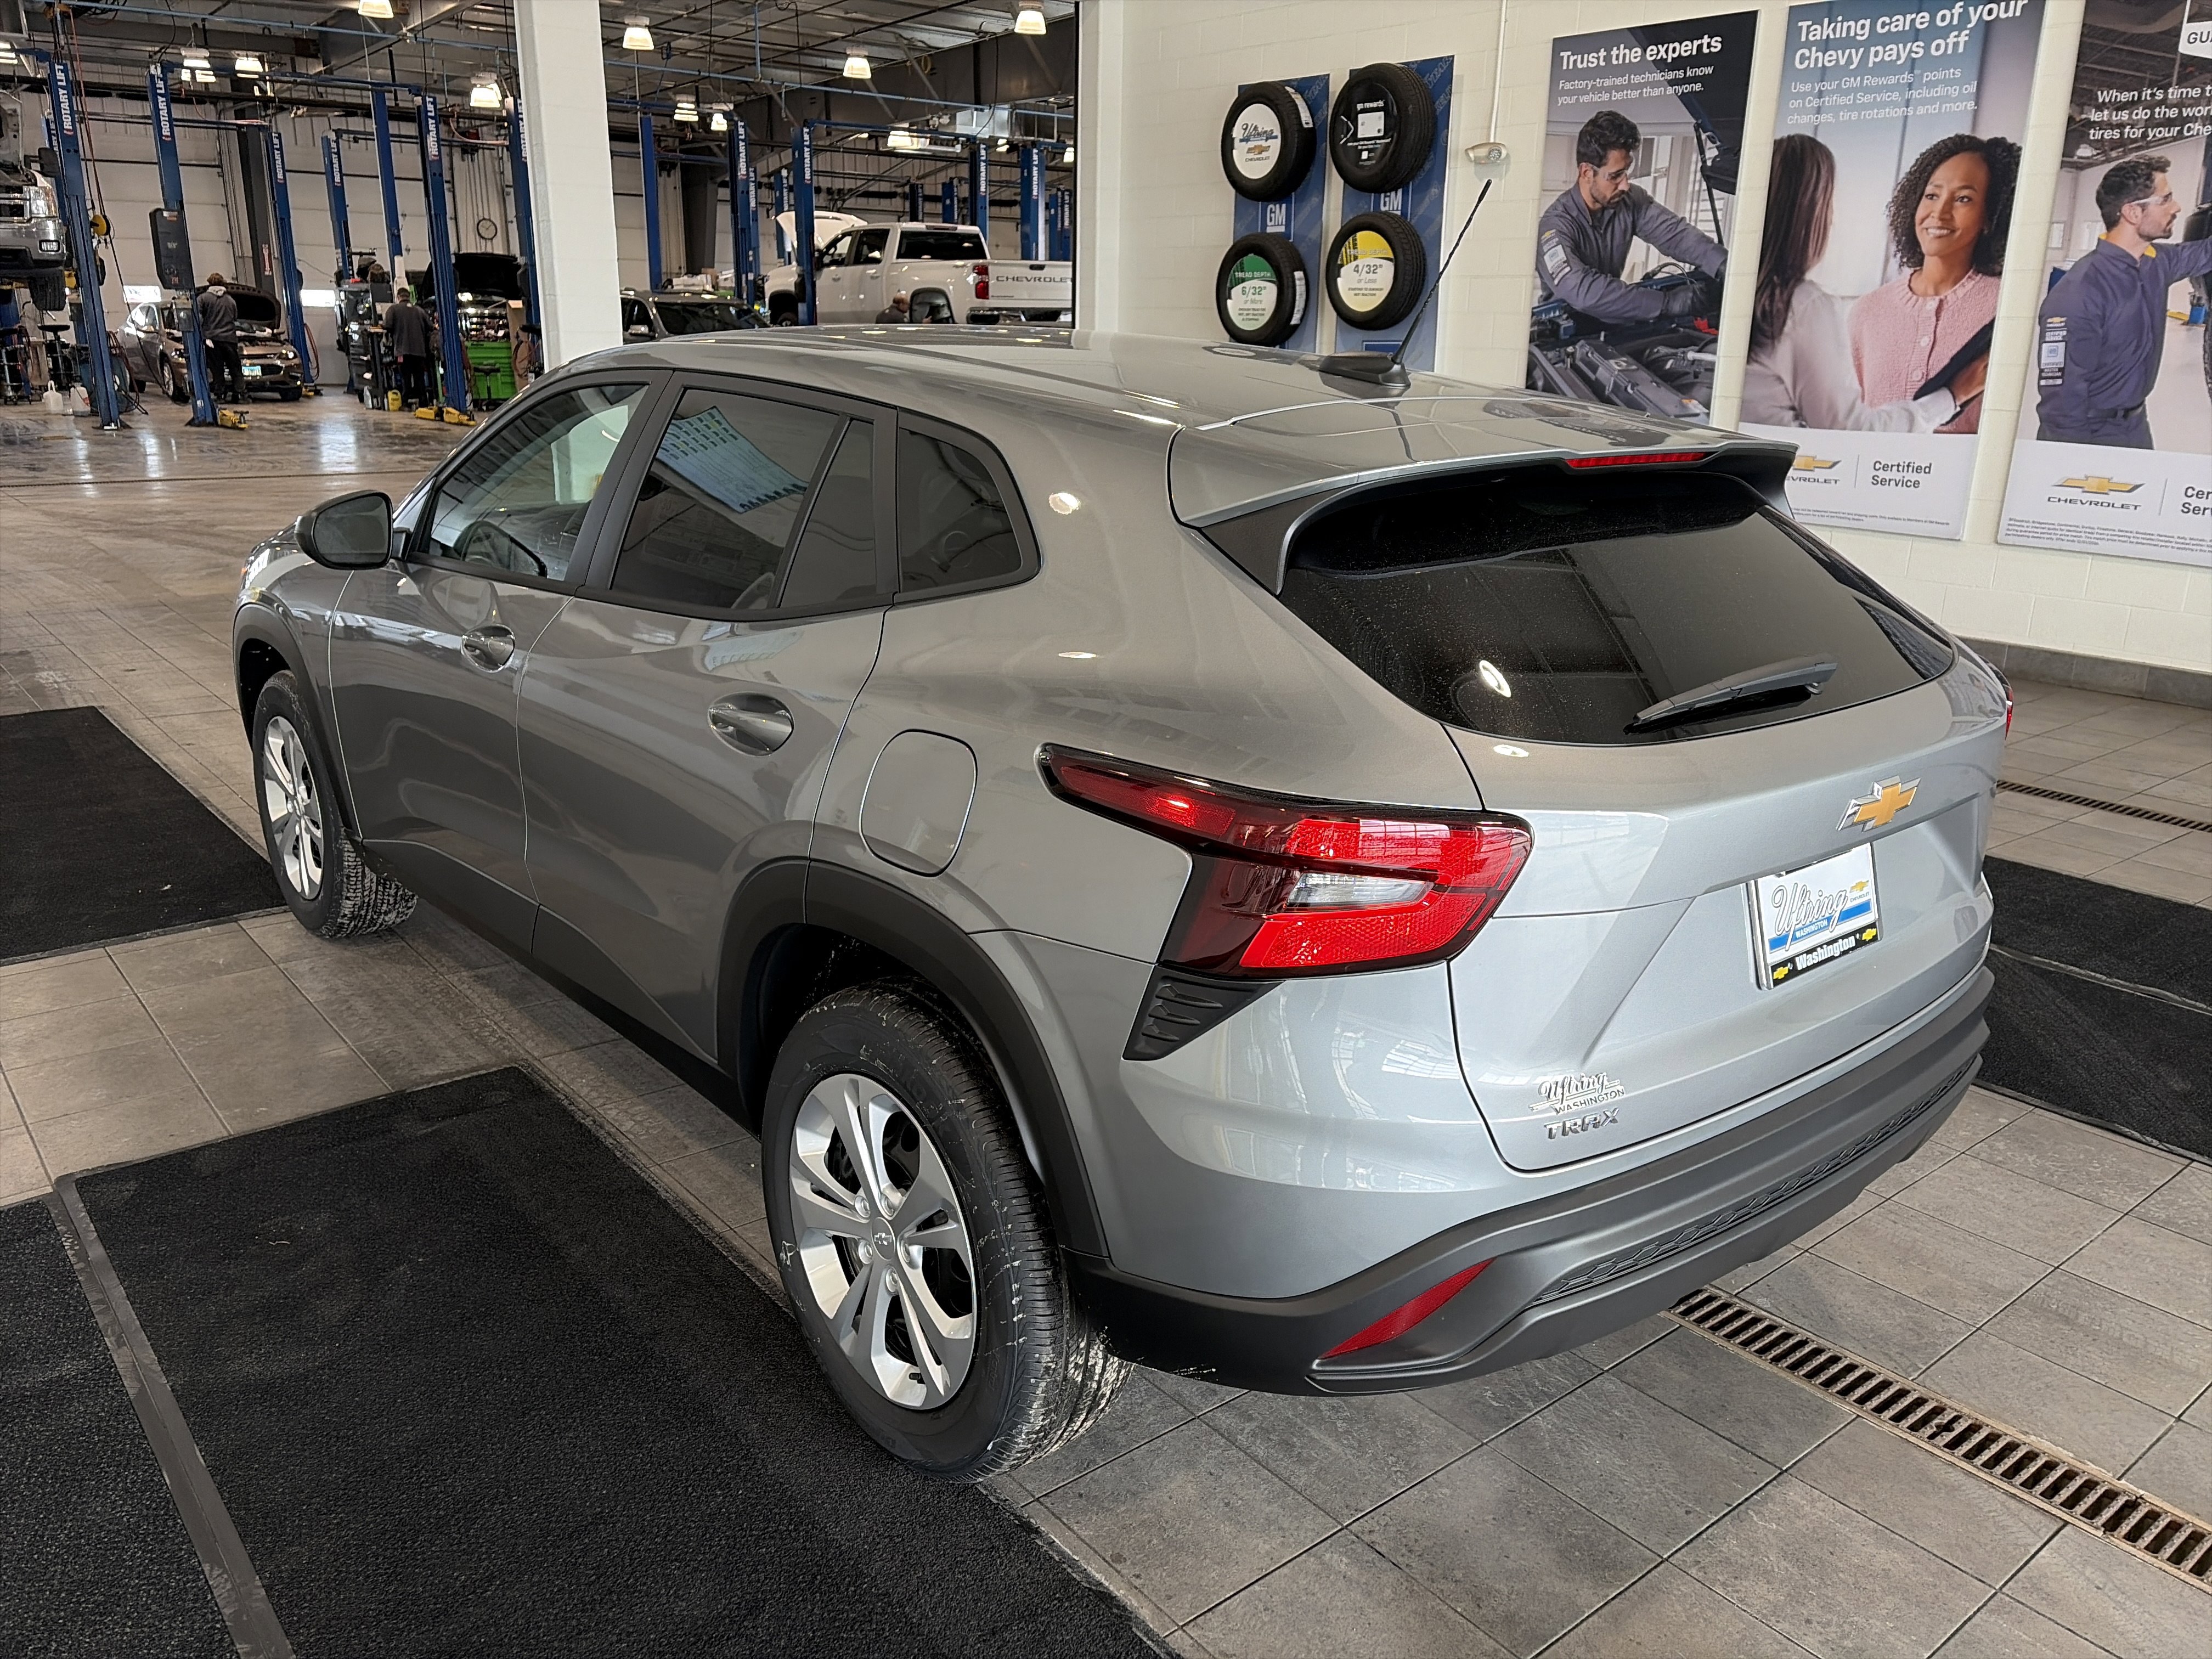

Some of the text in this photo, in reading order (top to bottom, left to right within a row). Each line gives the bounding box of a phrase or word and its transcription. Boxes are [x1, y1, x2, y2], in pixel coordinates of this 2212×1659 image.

[1798, 0, 2029, 42] Taking care of your
[2187, 30, 2212, 44] GU
[1560, 34, 1722, 70] Trust the experts
[1794, 30, 1971, 70] Chevy pays off
[1559, 65, 1714, 90] Factory-trained technicians know
[1791, 81, 1812, 93] Use
[1814, 80, 1839, 94] your
[1841, 77, 1860, 88] GM
[1922, 67, 1962, 83] points
[55, 63, 73, 130] ROTARY LIFT
[1558, 82, 1704, 106] your vehicle better than anyone.
[1789, 81, 1977, 108] on Certified Service, including oil
[2097, 84, 2212, 103] When it's time t
[157, 96, 171, 136] ROTARY
[1787, 100, 1978, 125] changes, tire rotations and more.
[2090, 108, 2109, 122] let
[2112, 110, 2129, 121] us
[2132, 106, 2151, 119] do
[2154, 105, 2179, 119] the
[426, 96, 439, 156] ROTARY LIFT
[2089, 122, 2212, 141] tires for your Che
[274, 149, 284, 179] ROTARY
[331, 153, 341, 183] ROTARY
[738, 140, 747, 175] ROTARY
[803, 146, 811, 179] ROTARY
[1380, 189, 1402, 212] GM
[1266, 204, 1286, 226] GM
[1353, 264, 1383, 276] 4/32"
[1242, 285, 1267, 298] 6/32"
[1785, 475, 1840, 484] EVROLET
[1873, 460, 1932, 474] Certified
[1871, 475, 1921, 488] Service
[2183, 486, 2212, 500] Cer
[2047, 496, 2142, 511] CHEVROLET
[1850, 891, 1870, 903] CHEVROLET
[1771, 882, 1848, 952] Uftring
[1796, 918, 1829, 939] WASHINGTON
[1795, 935, 1856, 970] Washington
[1538, 1071, 1607, 1104] Uftring
[1555, 1088, 1625, 1115] WASHINGTON
[1544, 1107, 1620, 1140] TRAX
